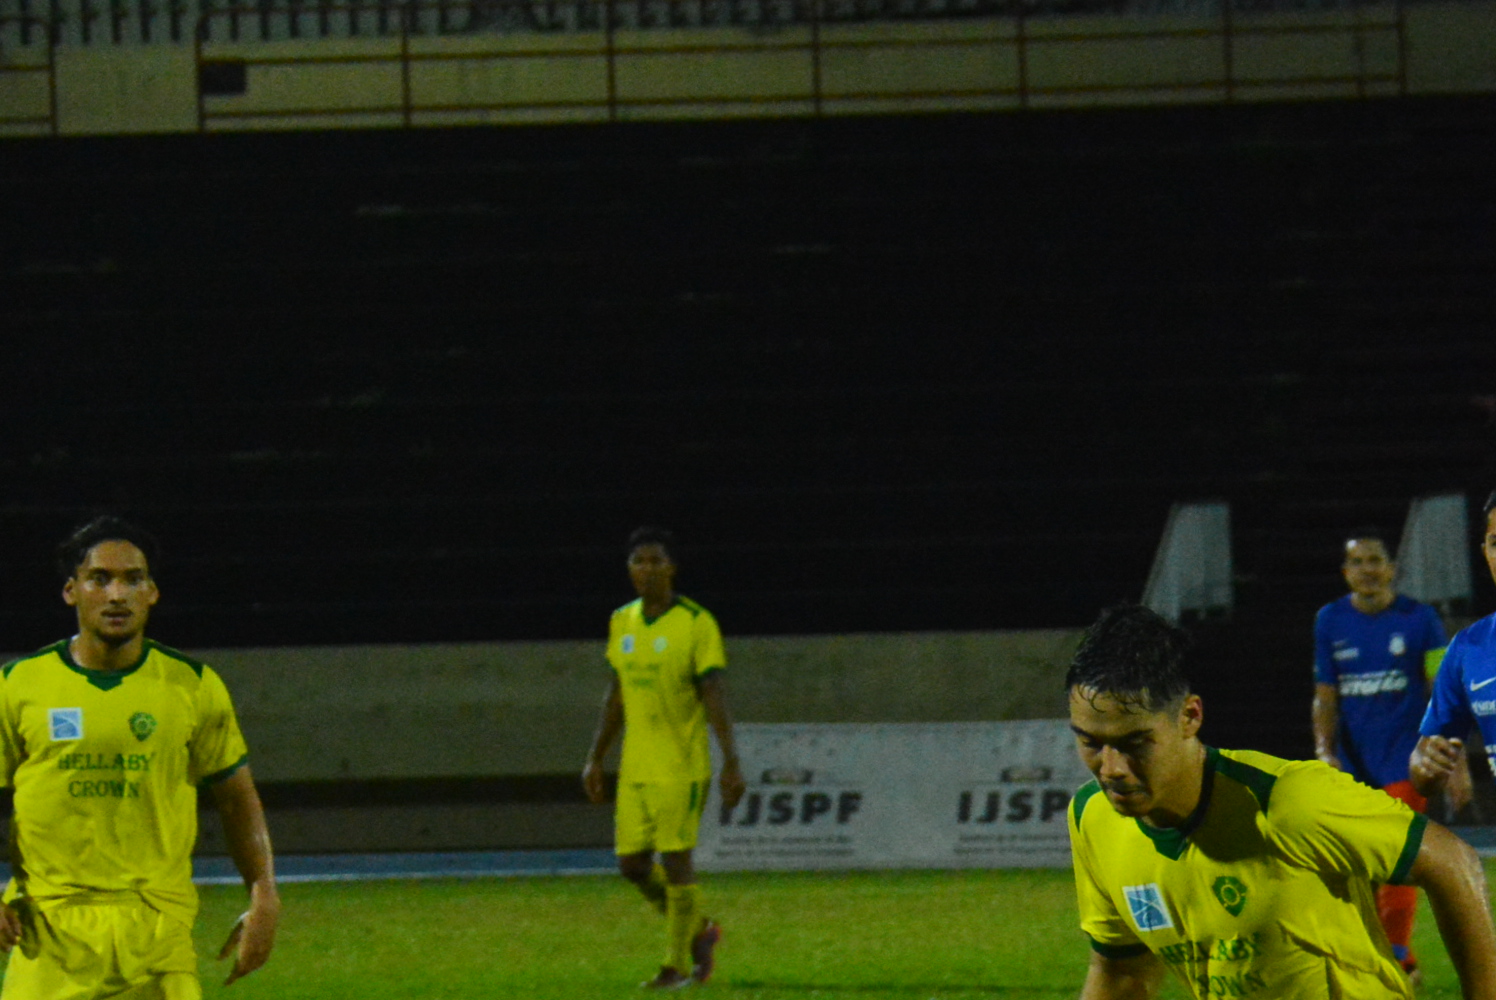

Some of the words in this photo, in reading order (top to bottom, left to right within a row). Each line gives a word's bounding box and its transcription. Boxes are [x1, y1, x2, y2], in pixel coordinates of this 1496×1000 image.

[57, 753, 150, 771] HELLABY
[68, 780, 140, 799] CROWN
[956, 789, 1071, 825] IJSP
